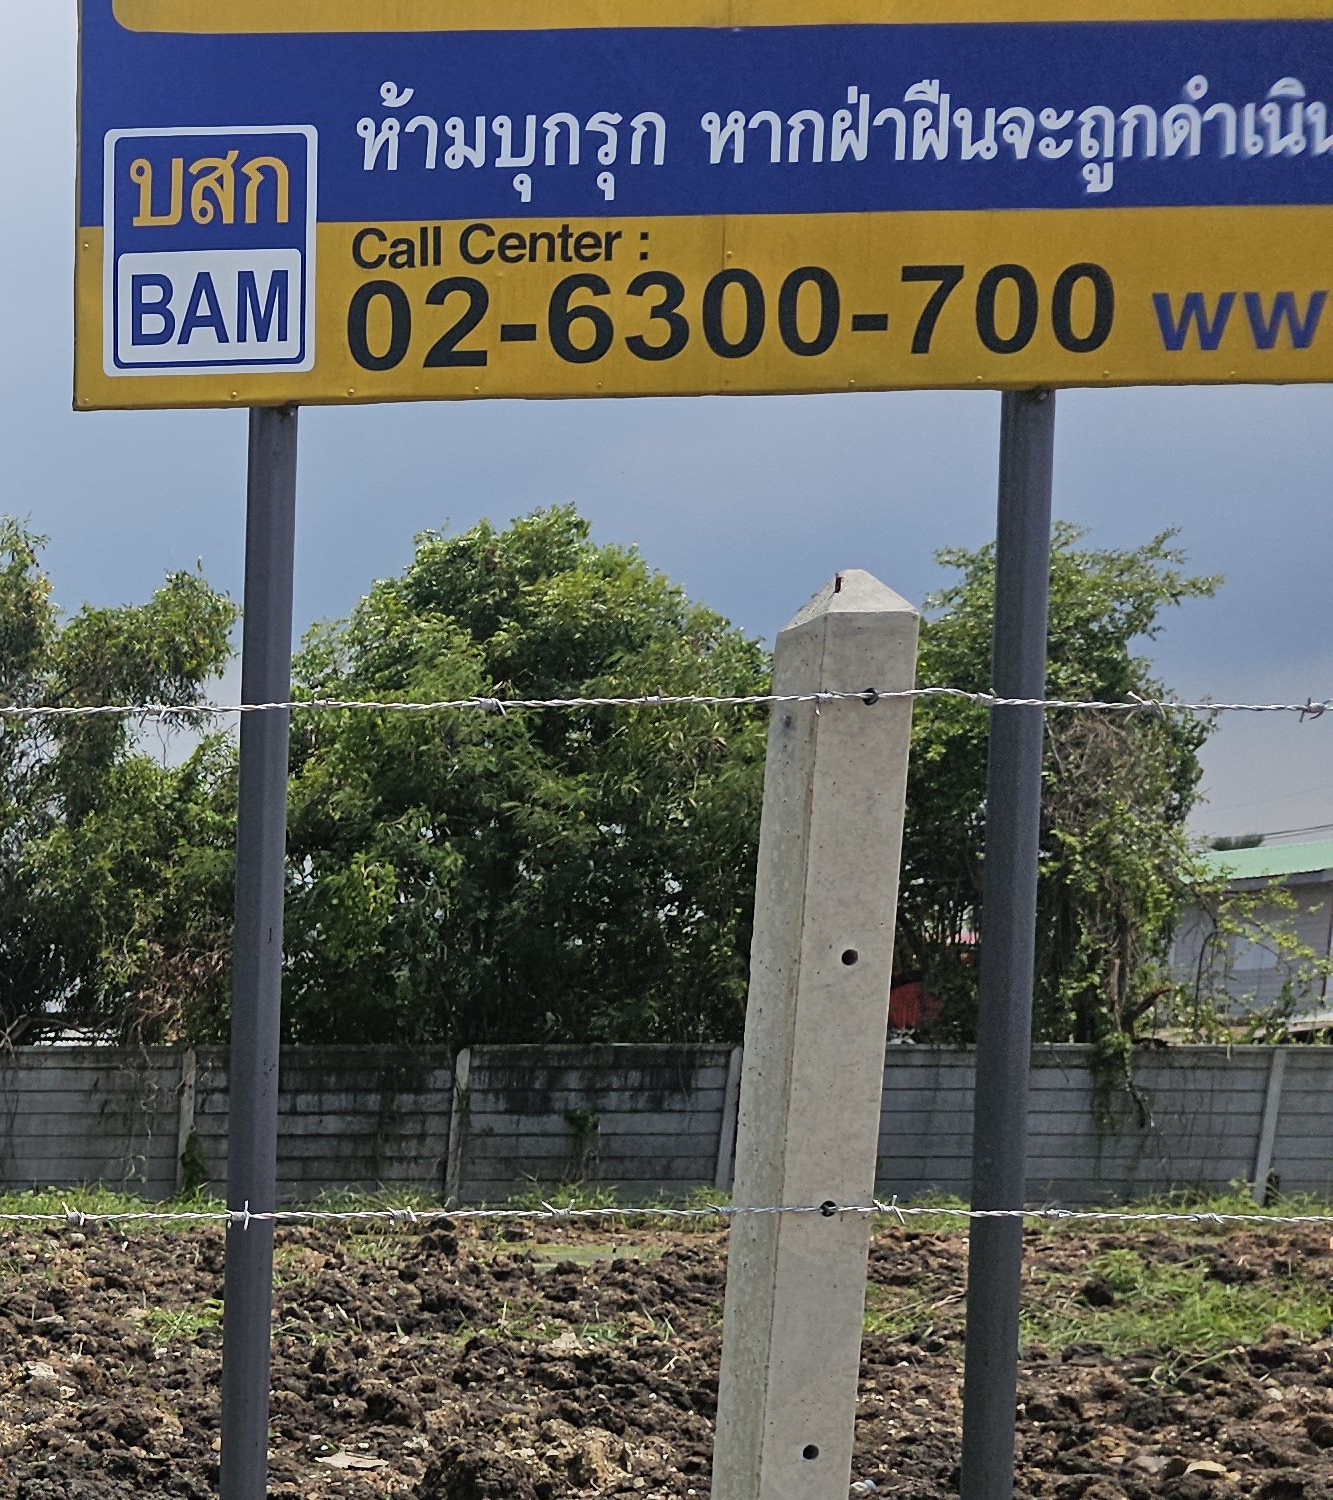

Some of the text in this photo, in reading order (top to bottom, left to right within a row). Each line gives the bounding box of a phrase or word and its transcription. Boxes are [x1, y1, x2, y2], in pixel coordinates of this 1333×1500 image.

[356, 81, 667, 203] ห้ามบุกรุก
[129, 150, 290, 227] บสก
[351, 226, 442, 269] Call
[130, 269, 290, 347] BAM
[346, 262, 1115, 372] 02-6300-700
